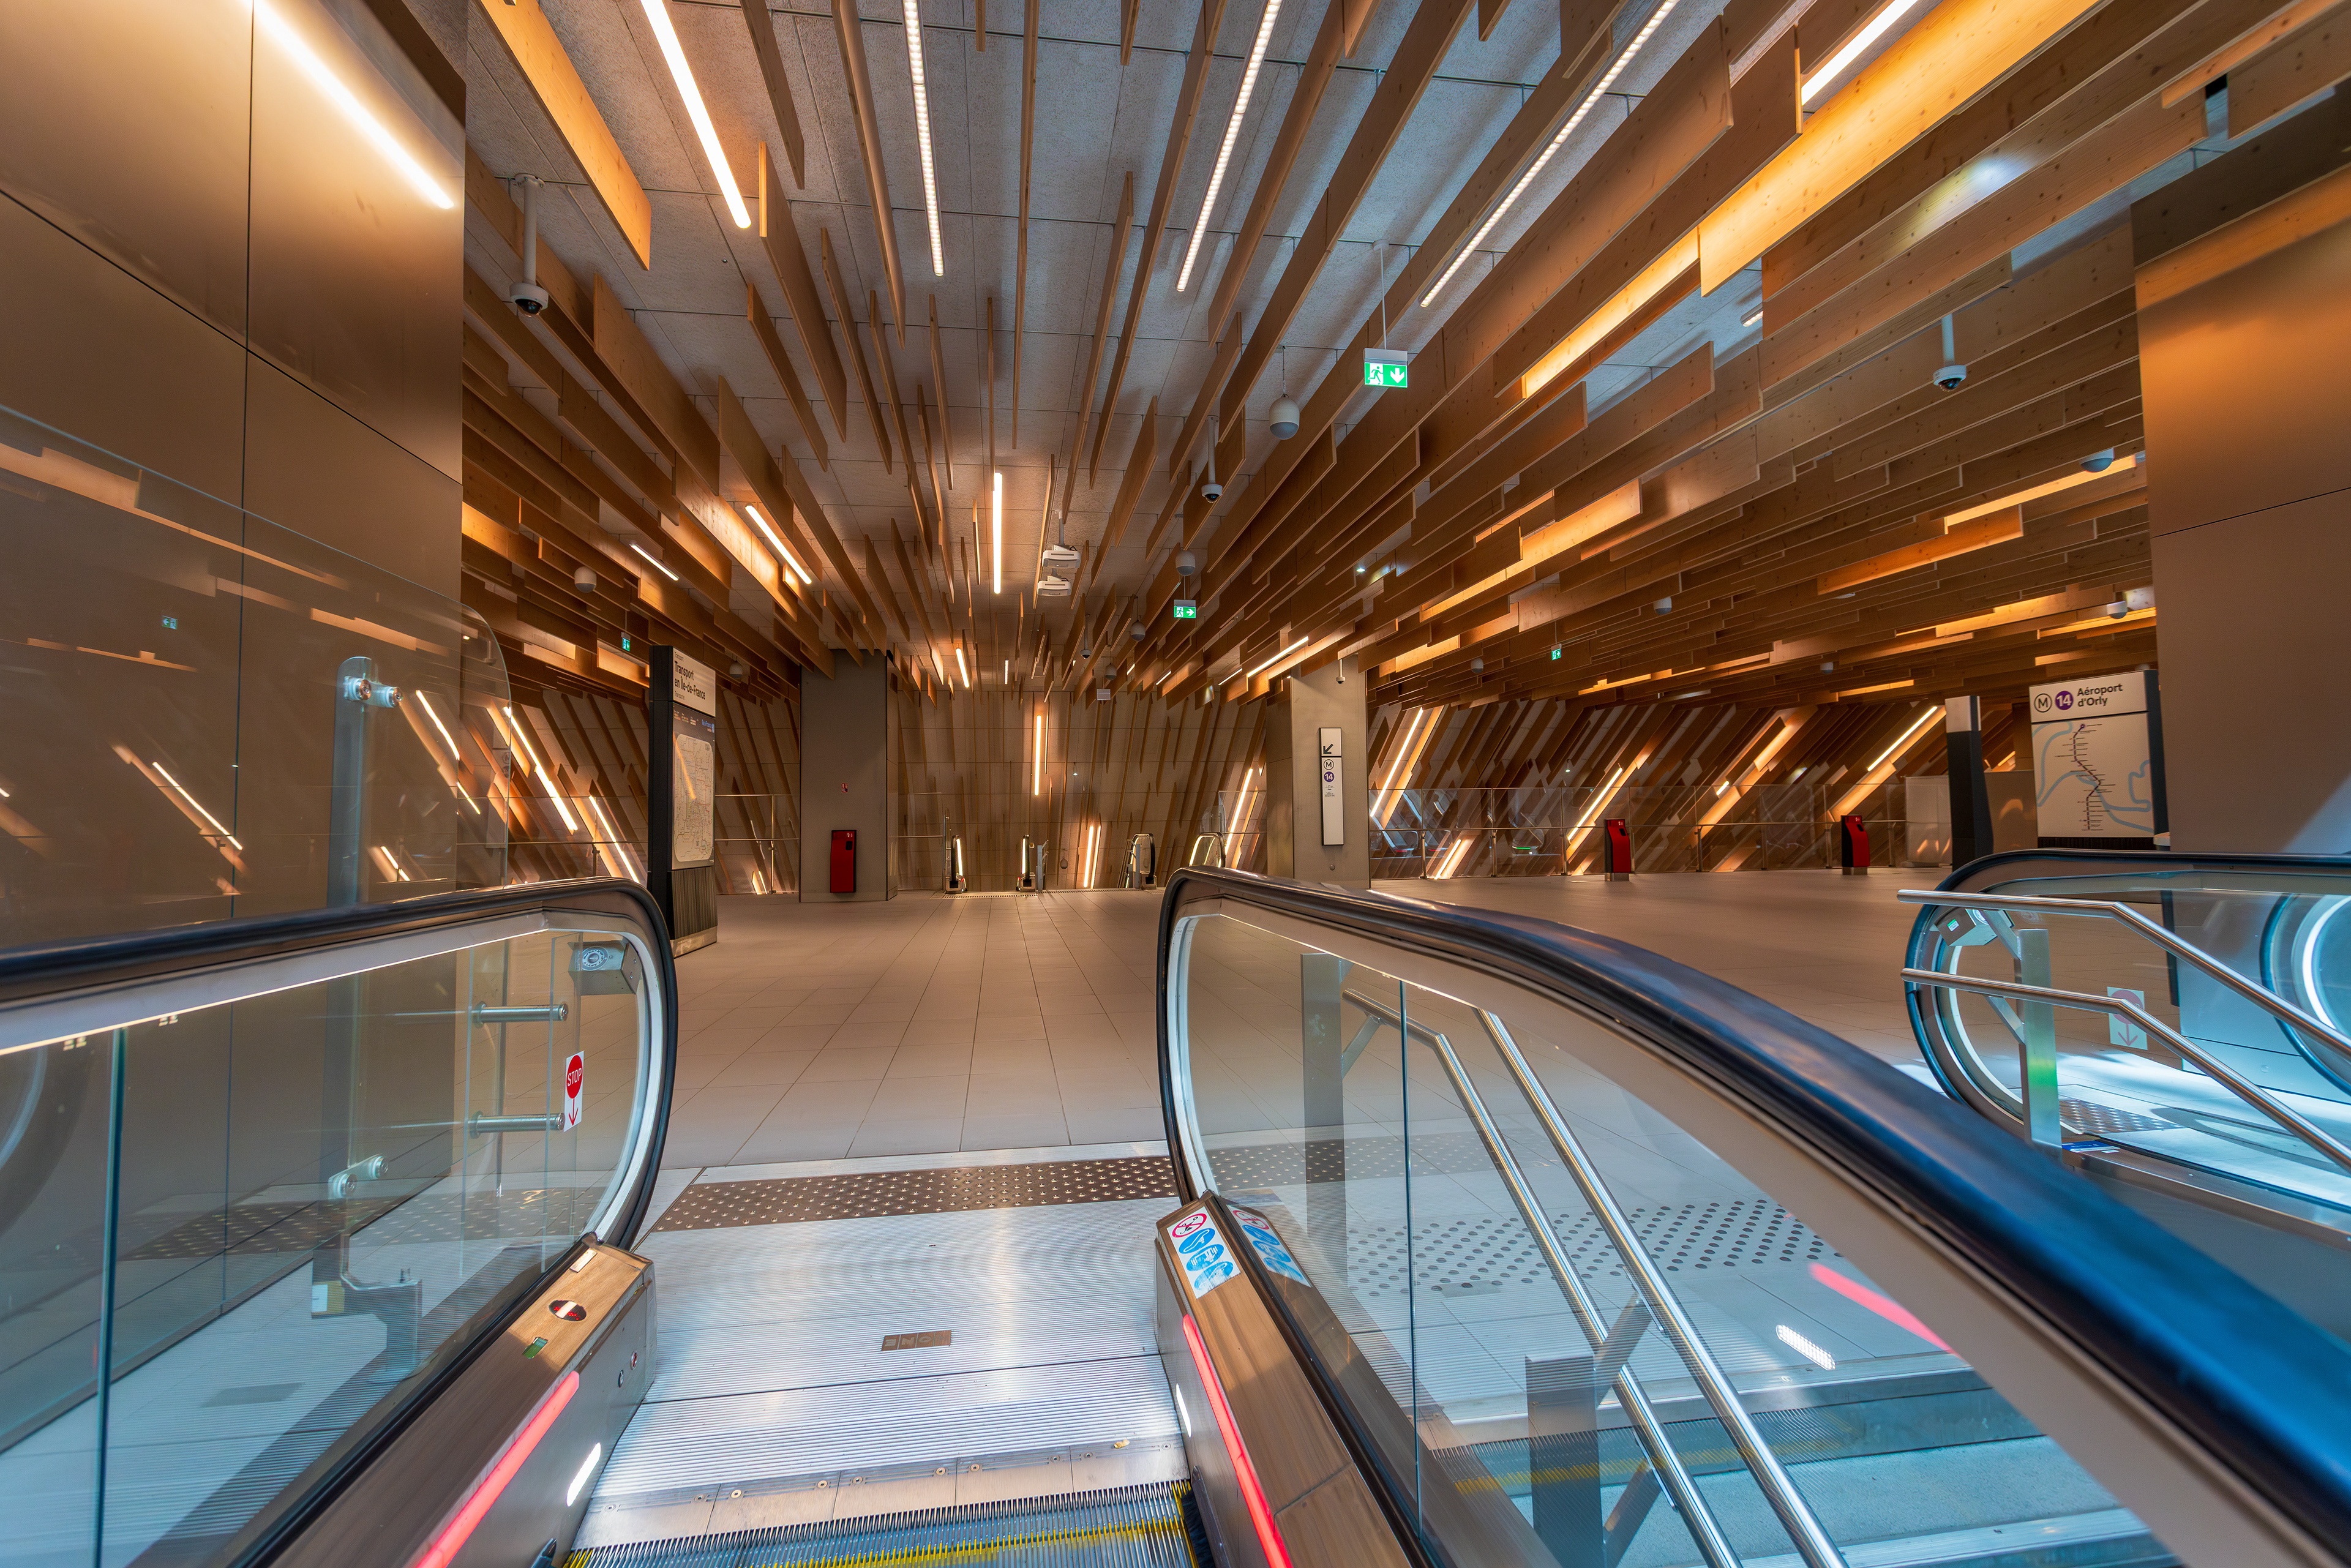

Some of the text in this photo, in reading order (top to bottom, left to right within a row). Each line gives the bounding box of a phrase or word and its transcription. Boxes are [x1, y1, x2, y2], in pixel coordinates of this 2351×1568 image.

[675, 660, 694, 681] Transport
[674, 675, 706, 700] en Île-de-France
[2057, 694, 2072, 707] 14
[2077, 684, 2123, 697] Aéroport
[2077, 696, 2108, 707] d'Orly
[568, 1067, 582, 1087] STOP
